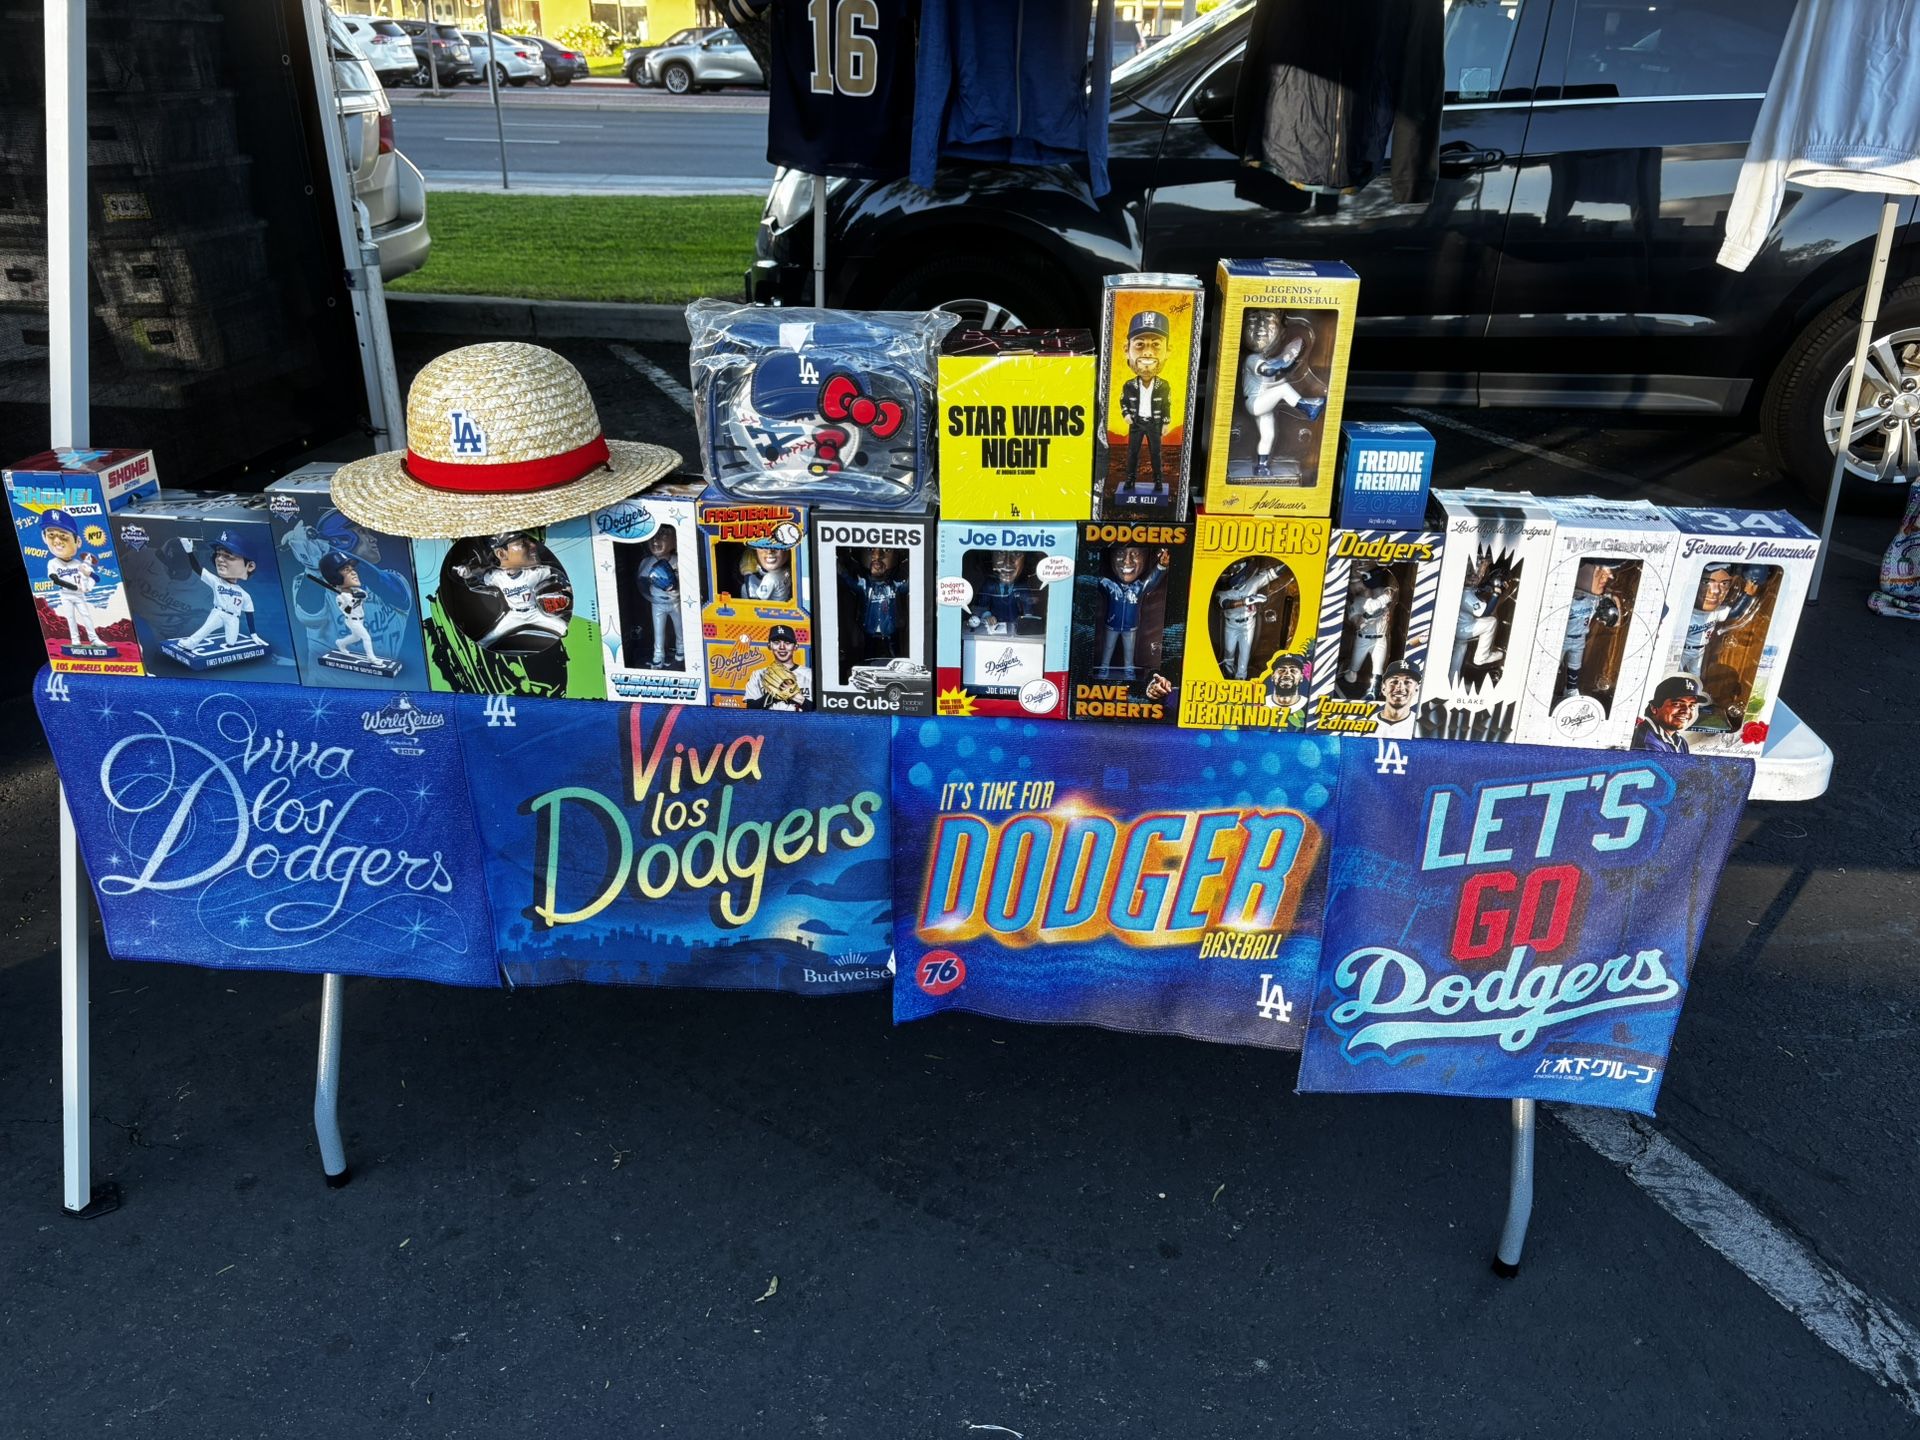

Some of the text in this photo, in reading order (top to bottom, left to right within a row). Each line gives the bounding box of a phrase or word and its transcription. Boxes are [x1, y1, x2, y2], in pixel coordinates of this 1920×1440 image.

[807, 0, 879, 97] 16
[1243, 294, 1341, 305] DODGER BASEBALL
[1265, 286, 1312, 294] LEGENDS
[1170, 302, 1191, 313] Dodgers
[798, 355, 819, 385] LA
[948, 405, 1085, 437] STAR WARS
[452, 413, 481, 453] LA
[981, 437, 1051, 469] NIGHT
[1358, 450, 1424, 473] FREDDIE
[108, 457, 150, 489] SHOHEI
[1354, 472, 1421, 491] FREEMAN
[13, 486, 92, 506] SHOHEI
[1126, 496, 1157, 504] JOE KELLY
[1353, 495, 1418, 513] 2024
[70, 505, 98, 514] DECOY
[270, 504, 300, 512] Champions
[704, 506, 791, 523] FASTBALL
[1011, 503, 1020, 517] LA
[597, 506, 651, 533] Dodgers
[1698, 511, 1787, 534] 34
[720, 521, 777, 540] FURY
[820, 526, 921, 546] DODGERS
[959, 529, 1056, 548] Joe Davis
[1086, 525, 1186, 544] DODGERS
[1203, 520, 1323, 555] DODGERS
[1451, 520, 1551, 541] Los Angeles Dodgers
[24, 547, 48, 558] WOOF!
[1336, 531, 1434, 563] Dodgers
[1564, 536, 1601, 553] Tyler
[1682, 538, 1817, 560] Fernando Valenzuela
[34, 581, 54, 591] RUFF!
[503, 584, 529, 597] Dodgers
[940, 582, 965, 590] Dodgers
[233, 598, 241, 606] 17
[522, 593, 531, 601] 17
[1127, 590, 1138, 603] LA
[56, 663, 138, 673] LOS ANGELES DODGERS
[710, 647, 766, 673] Dodgers
[985, 657, 1021, 674] Dodgers
[1400, 660, 1410, 669] LA
[45, 671, 69, 702] LA
[615, 684, 699, 700] YAMAMOTO
[986, 686, 1017, 695] JOE DAVIS
[1076, 684, 1128, 700] DAVE
[1186, 681, 1267, 705] TEOSCAR
[1686, 679, 1695, 690] LA
[823, 695, 900, 710] Ice Cube
[1025, 689, 1053, 704] Dodgers
[1316, 695, 1378, 716] Tommy
[483, 694, 517, 728] LA
[1075, 702, 1163, 719] ROBERTS
[1560, 712, 1596, 728] Dodgers
[361, 710, 445, 735] World Series
[1318, 713, 1378, 733] Edman
[629, 703, 765, 802] Viva
[1374, 740, 1408, 775] LA
[252, 776, 333, 835] los
[940, 780, 1056, 811] IT'S TIME FOR
[99, 711, 454, 932] Dodgers
[651, 792, 709, 836] los
[1421, 769, 1657, 871] LET'S
[530, 784, 883, 927] Dodgers
[918, 808, 1316, 945] DODGER
[1451, 865, 1581, 960] GO
[1199, 932, 1284, 961] BASEBALL
[804, 967, 892, 984] Budweise
[922, 958, 959, 986] 76
[1256, 973, 1292, 1022] LA
[1331, 946, 1679, 1052] Dodgers
[1553, 1057, 1657, 1084] 木下グループ
